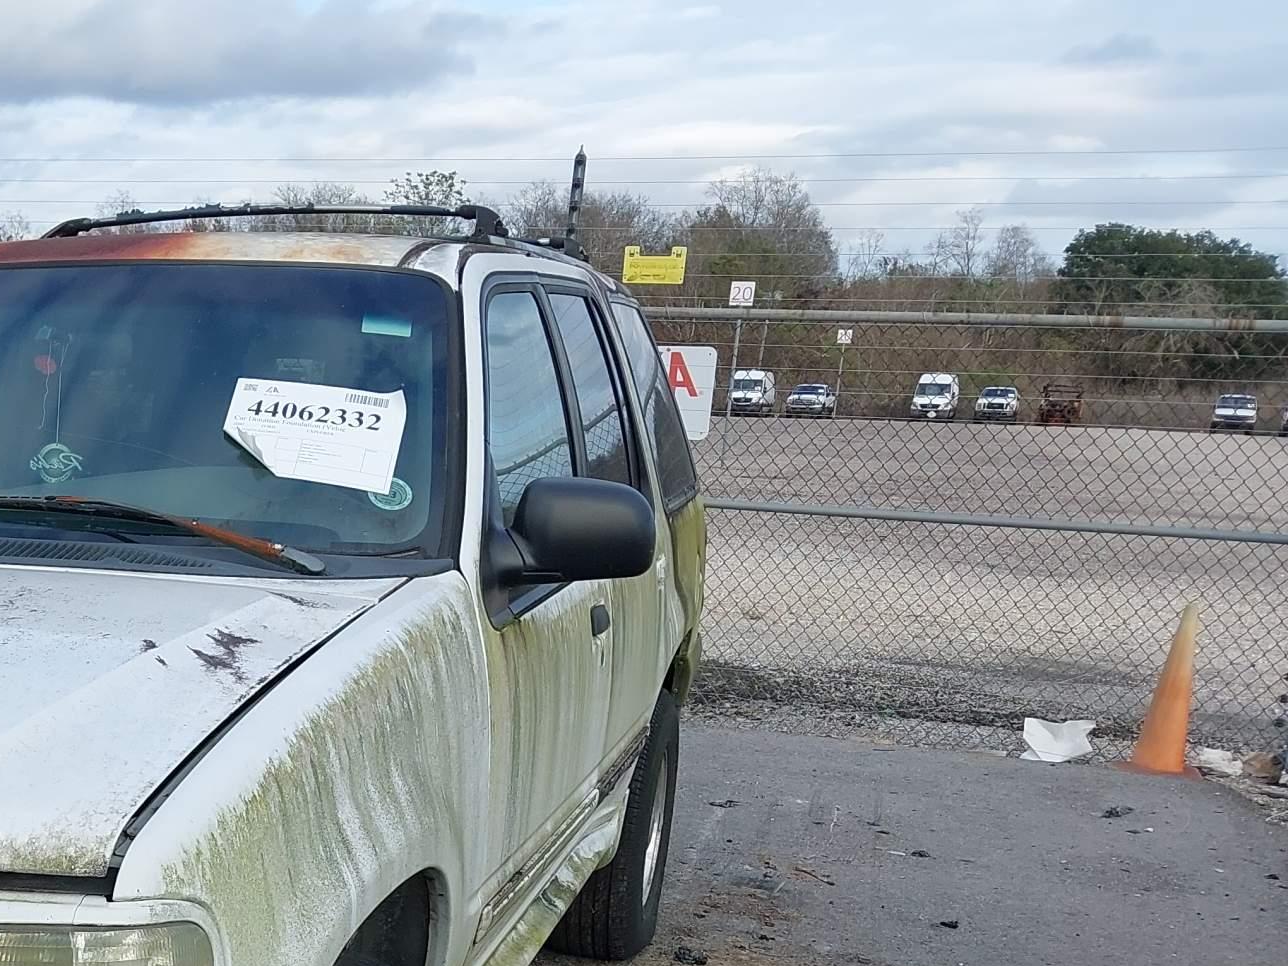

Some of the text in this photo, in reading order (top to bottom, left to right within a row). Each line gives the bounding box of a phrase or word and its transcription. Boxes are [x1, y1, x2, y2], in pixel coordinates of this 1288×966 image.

[732, 286, 753, 301] 20
[669, 351, 698, 397] A
[247, 400, 382, 431] 44062332
